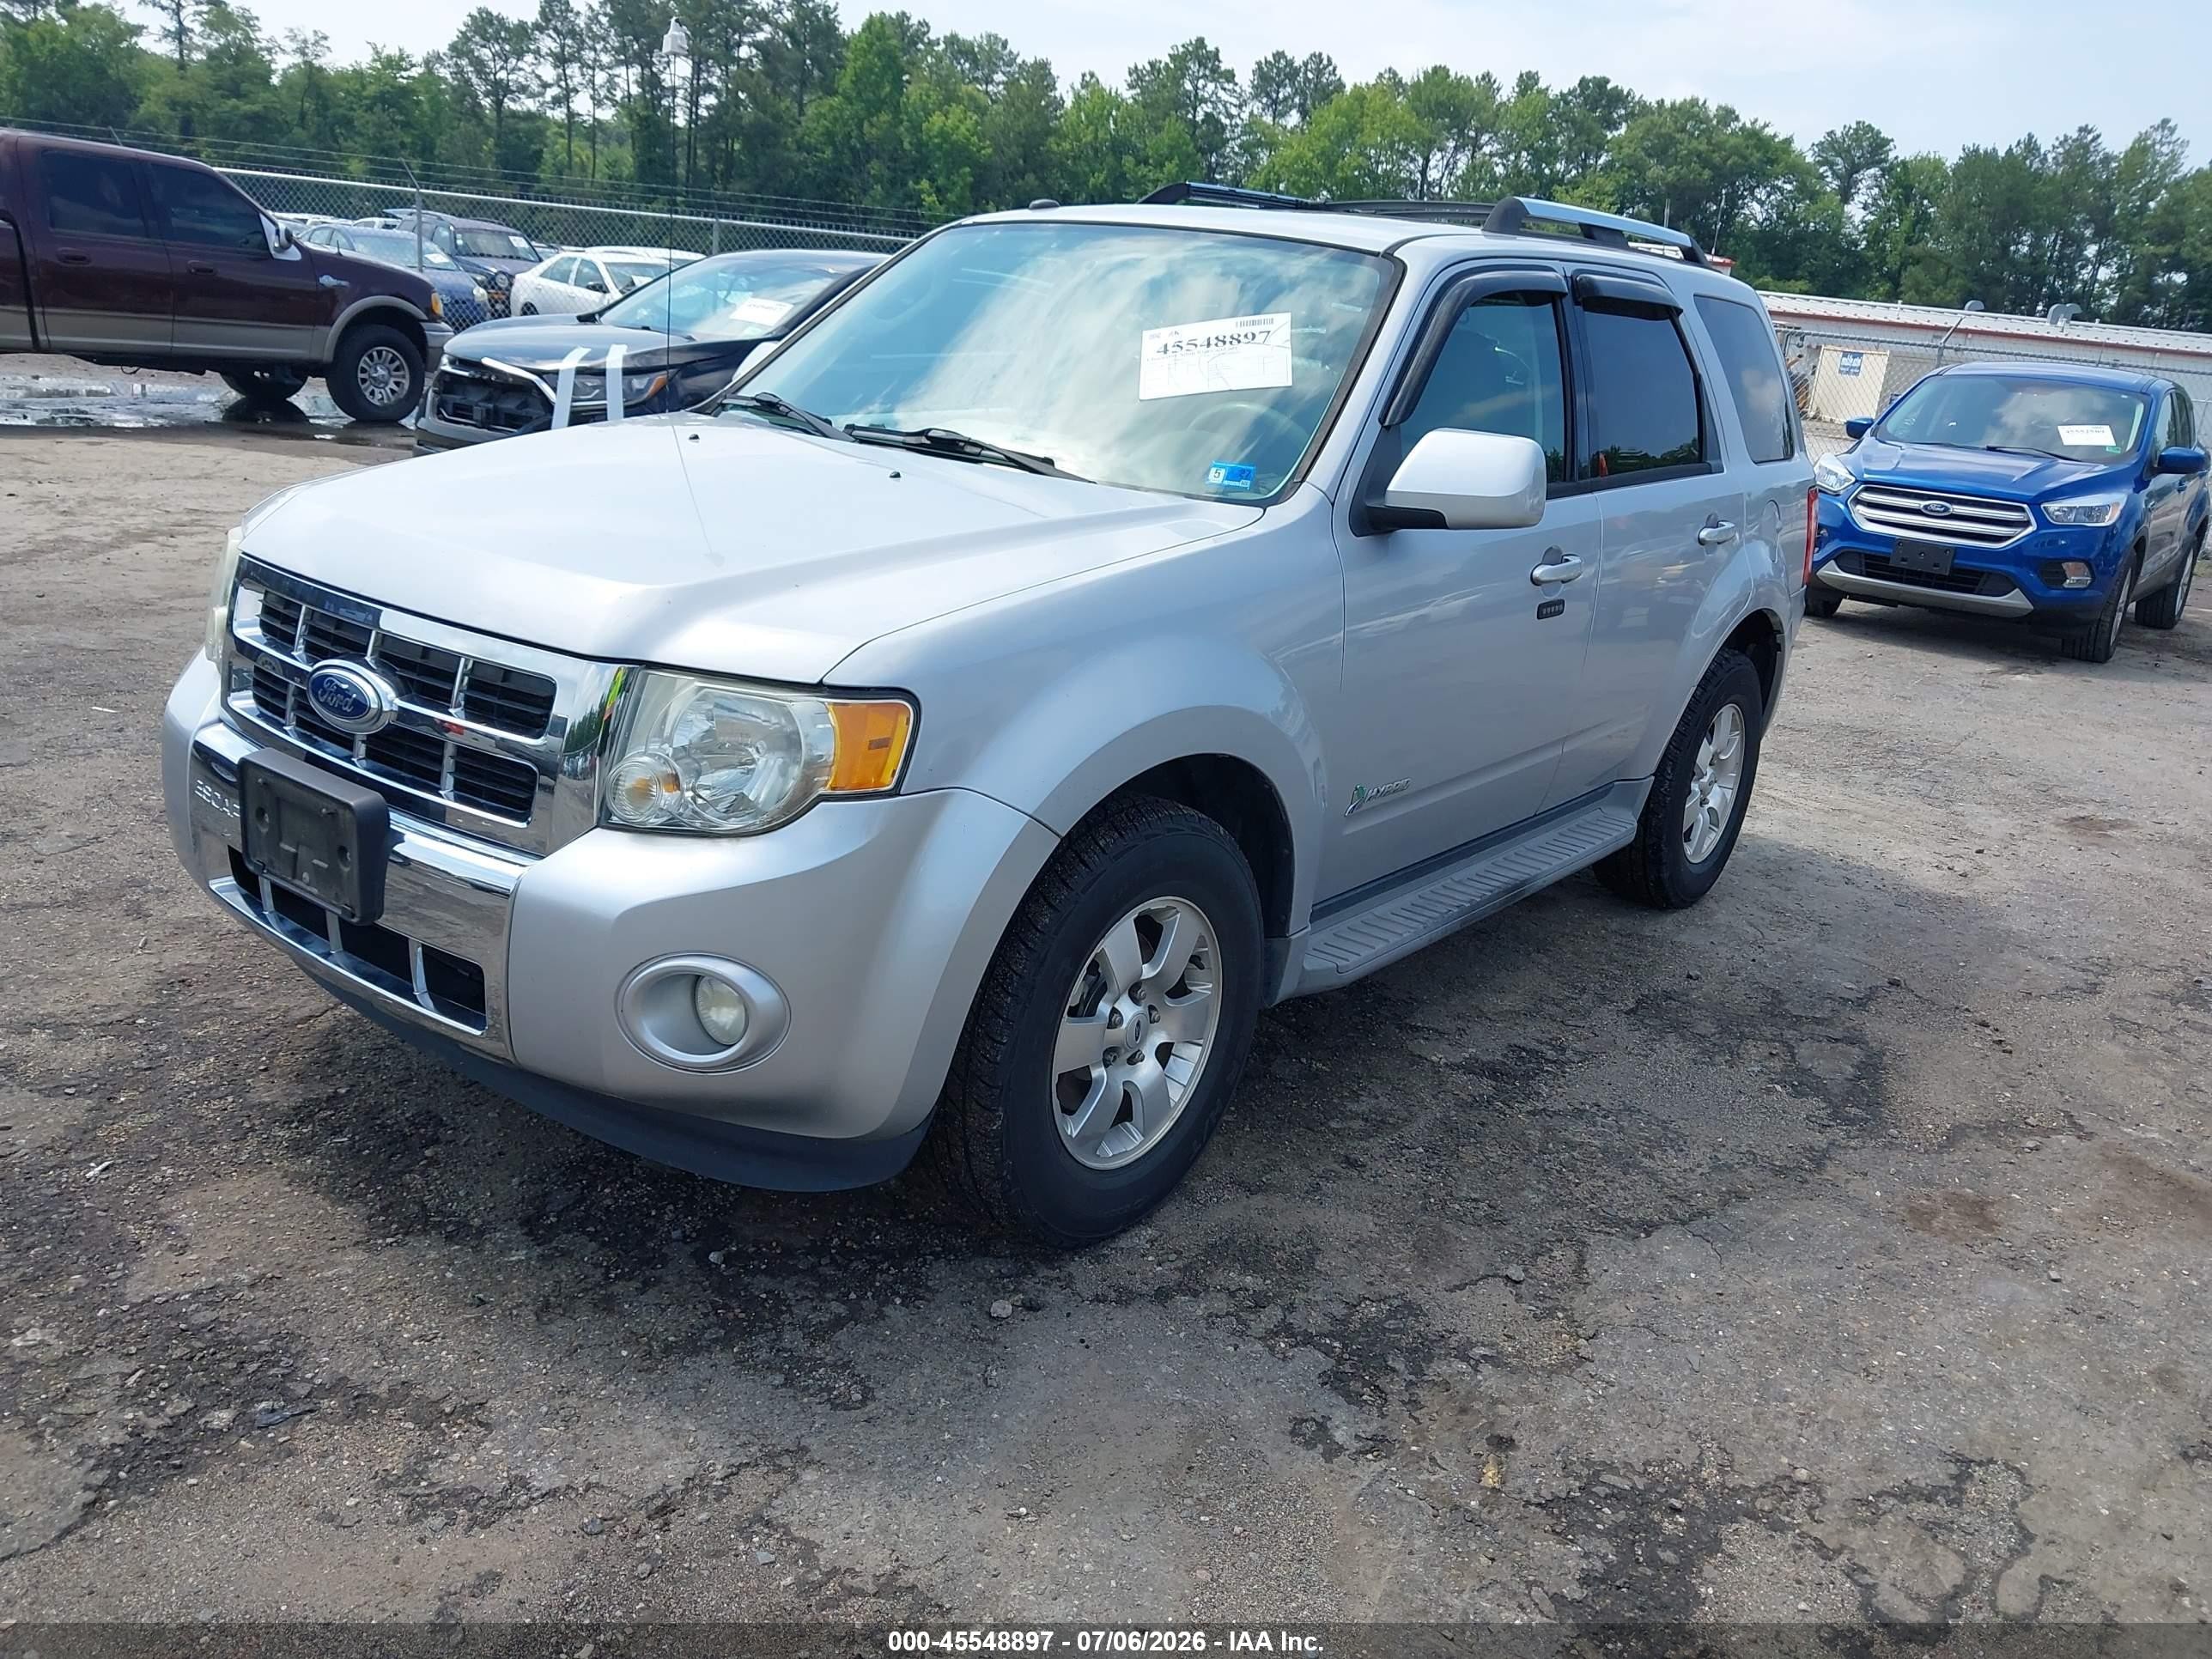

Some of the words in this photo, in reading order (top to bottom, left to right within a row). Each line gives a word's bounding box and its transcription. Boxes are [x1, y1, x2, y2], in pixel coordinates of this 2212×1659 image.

[1156, 331, 1272, 355] 45548897
[1213, 468, 1221, 479] 5
[318, 677, 357, 713] Ford
[194, 779, 241, 819] ESCAP
